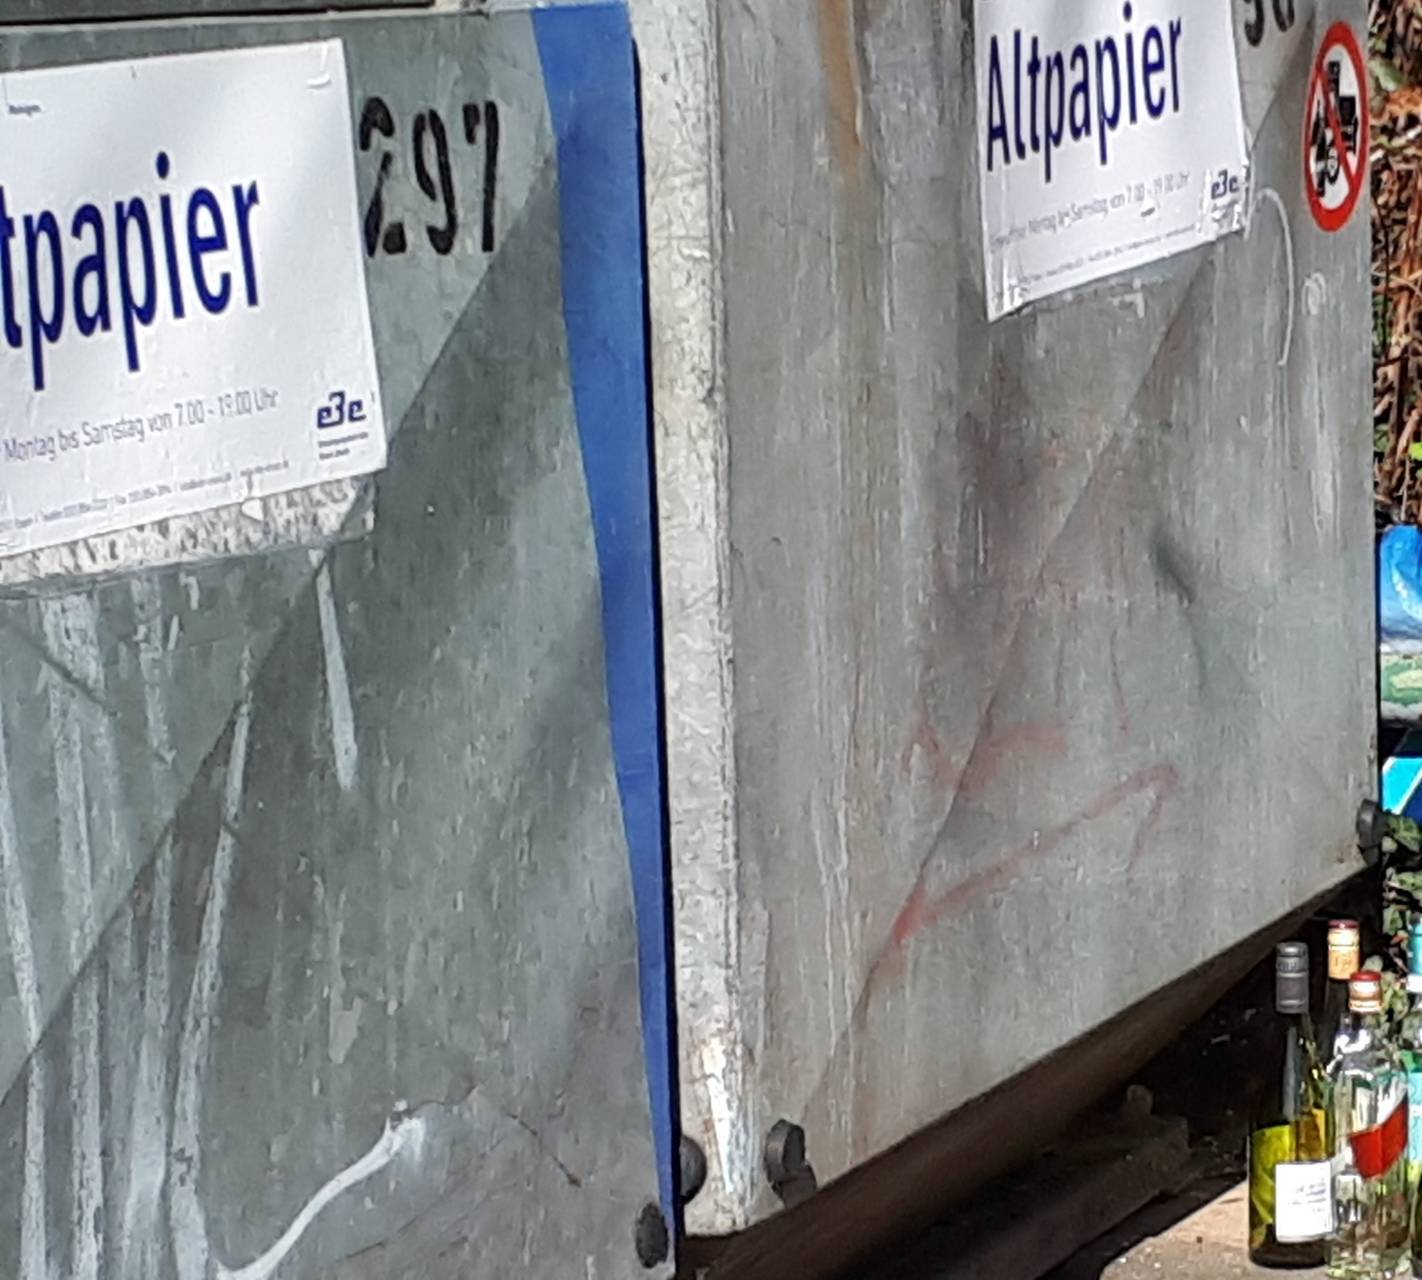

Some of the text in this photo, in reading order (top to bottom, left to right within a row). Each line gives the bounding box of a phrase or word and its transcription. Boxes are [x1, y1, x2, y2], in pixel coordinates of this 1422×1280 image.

[359, 97, 499, 257] 297
[987, 1, 1181, 183] Altpapier
[0, 151, 259, 390] tpapier
[4, 438, 55, 461] Montag
[58, 428, 78, 451] bis
[81, 415, 144, 446] Samstag
[148, 411, 173, 432] von
[174, 399, 205, 427] 7.00
[254, 386, 279, 412] Uhr
